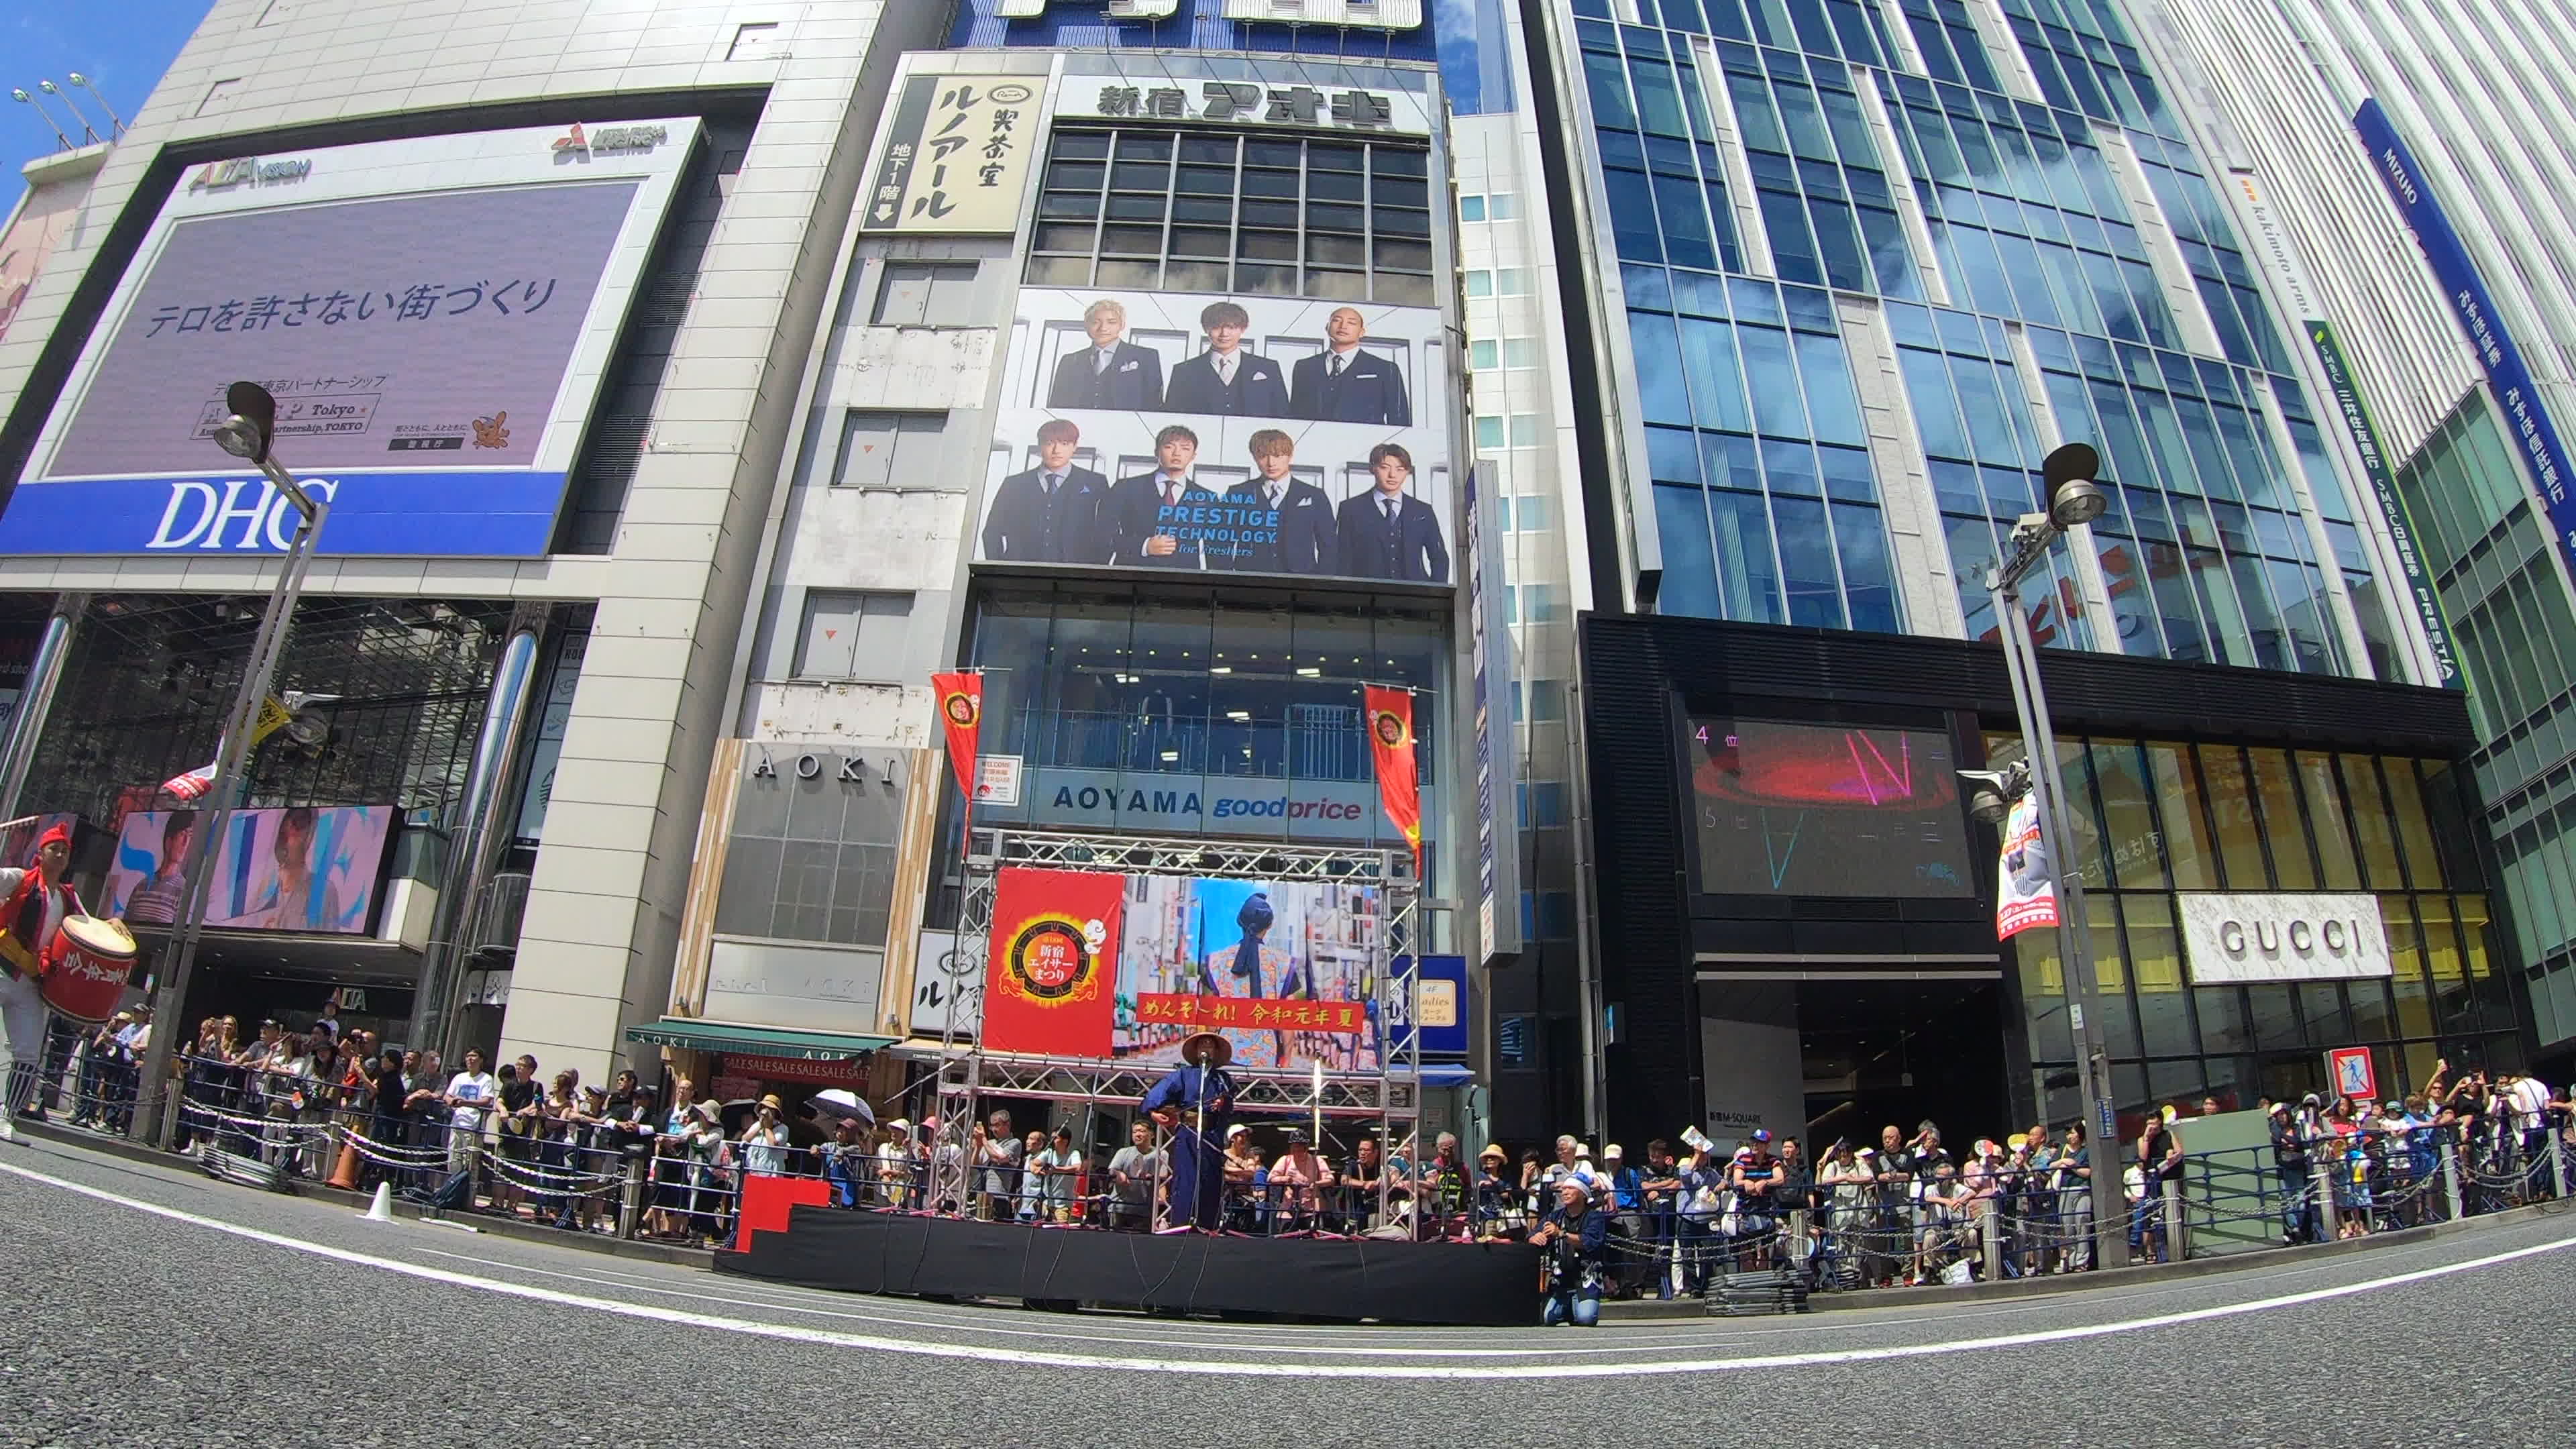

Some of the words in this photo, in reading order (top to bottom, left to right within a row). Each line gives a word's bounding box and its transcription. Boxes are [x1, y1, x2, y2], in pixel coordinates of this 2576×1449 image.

[910, 85, 983, 220] ルノアール
[978, 109, 1019, 187] 喫茶室
[878, 143, 911, 201] 地下1階
[2383, 148, 2417, 205] MIZUHO
[2252, 205, 2292, 273] kakimoto
[2286, 276, 2311, 315] arms
[146, 278, 557, 338] テロを許さない街づくり
[2457, 289, 2502, 369] みずほ証券
[312, 404, 356, 419] Tokyo
[2320, 344, 2343, 384] SMBC
[2337, 389, 2380, 470] 三井住友銀行
[274, 425, 323, 435] artnership,
[2506, 386, 2566, 505] みずほ信託銀行
[1183, 490, 1256, 504] AOYAMA
[146, 478, 339, 551] DHC
[1158, 504, 1280, 527] PRESTIGE
[1155, 525, 1277, 544] TECHNOLOGY
[1695, 725, 1709, 745] 4
[753, 751, 896, 784] AOKI
[1053, 785, 1203, 814] AOYAMA
[1040, 944, 1065, 958] 新宿
[2220, 919, 2363, 955] GUCCI
[1028, 958, 1074, 970] エイサー
[1034, 969, 1065, 982] まつり
[1421, 996, 1450, 1007] adies
[638, 1034, 689, 1049] AOKI
